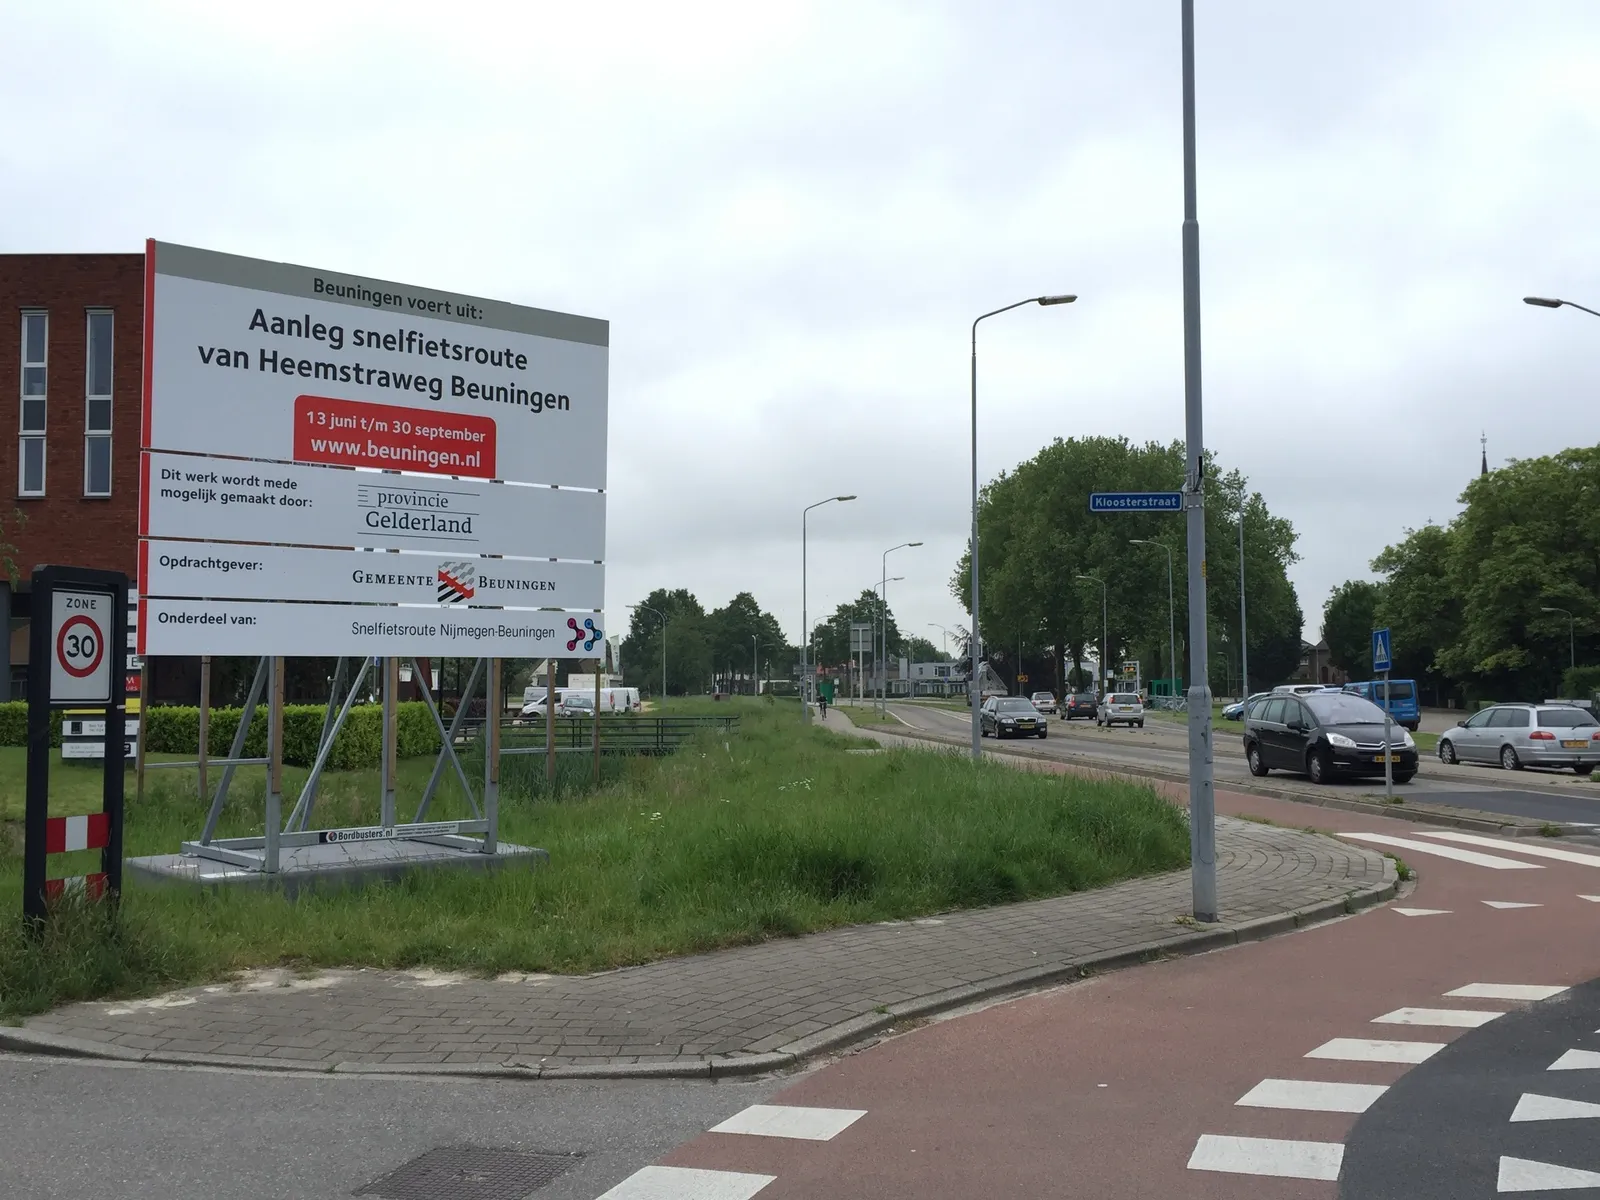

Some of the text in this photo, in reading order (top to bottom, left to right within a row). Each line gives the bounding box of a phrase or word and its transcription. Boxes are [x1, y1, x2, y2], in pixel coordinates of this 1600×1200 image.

[313, 277, 483, 320] Beuningen voert uit:
[249, 308, 528, 371] Aanleg snelfietsroute
[198, 345, 570, 413] van Heemstraweg Beuningen
[306, 410, 486, 443] 13 juni t/m 30 september
[311, 437, 481, 469] www.beuningen.nl
[161, 468, 298, 490] Dit werk wordt mede
[160, 486, 313, 508] mogelijk gemaakt door:
[377, 491, 449, 508] provincie
[1095, 497, 1177, 507] Kloosterstraat
[365, 511, 473, 534] Gelderland
[159, 555, 263, 573] Opdrachtgever:
[352, 569, 556, 591] GEMEENTE BEUNINGEN
[66, 597, 97, 610] ZONE
[158, 611, 257, 626] Onderdeel van:
[351, 621, 555, 641] Snelfietsroute Nijmegen-Beuningen
[66, 634, 95, 658] 30
[338, 828, 393, 841] Bordbusters.nl
